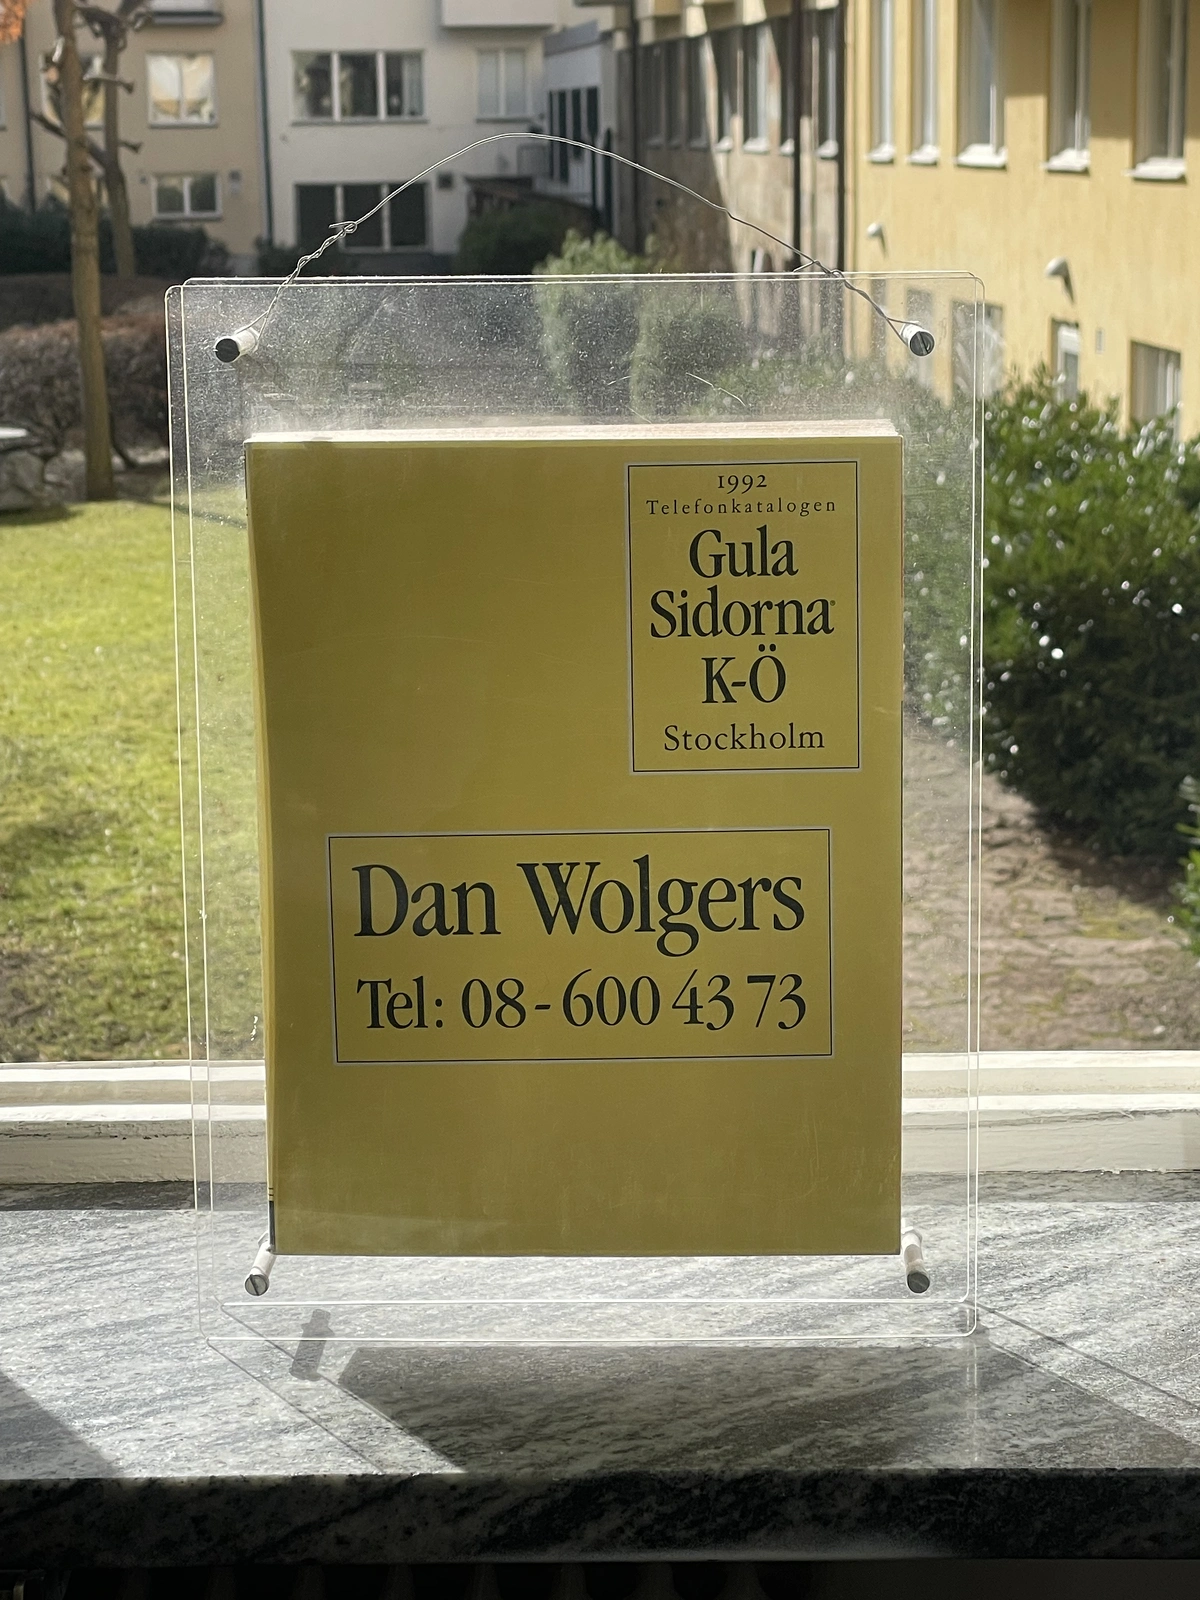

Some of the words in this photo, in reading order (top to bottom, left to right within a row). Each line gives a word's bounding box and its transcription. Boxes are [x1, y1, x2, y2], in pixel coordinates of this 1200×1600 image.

[646, 497, 836, 517] Telefonkatalogen
[717, 474, 768, 494] 1992
[689, 524, 799, 578] Gula
[650, 584, 835, 639] Sidorna
[701, 643, 787, 704] K-Ö
[664, 721, 825, 751] Stockholm
[351, 864, 501, 937] Dan
[516, 854, 805, 958] Wolgers
[356, 975, 444, 1030] Tel:
